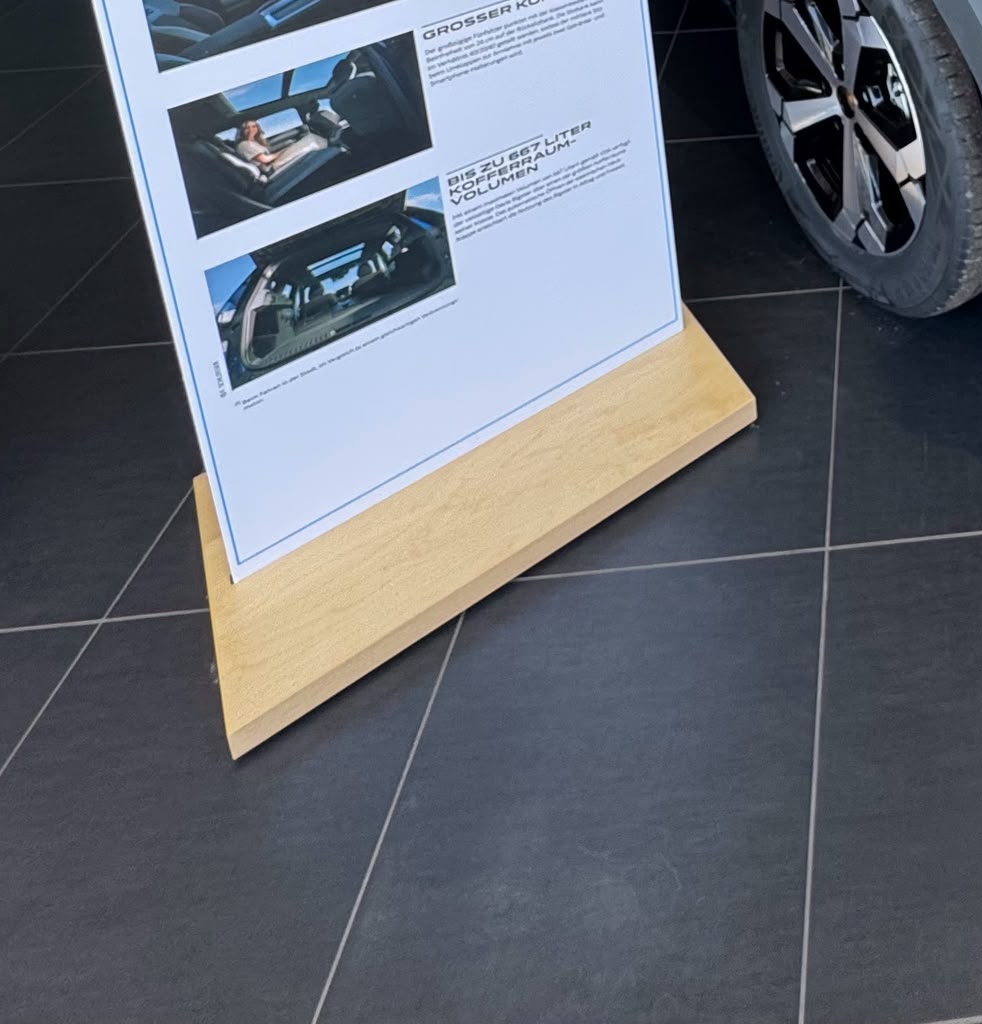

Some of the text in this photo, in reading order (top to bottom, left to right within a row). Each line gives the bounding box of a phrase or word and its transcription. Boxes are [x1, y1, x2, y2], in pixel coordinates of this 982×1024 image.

[422, 4, 512, 41] GROSSER
[447, 120, 592, 187] BIS ZU 667 LITER
[448, 138, 577, 197] KOFFERRAUM-
[450, 163, 539, 206] VOLUMEN
